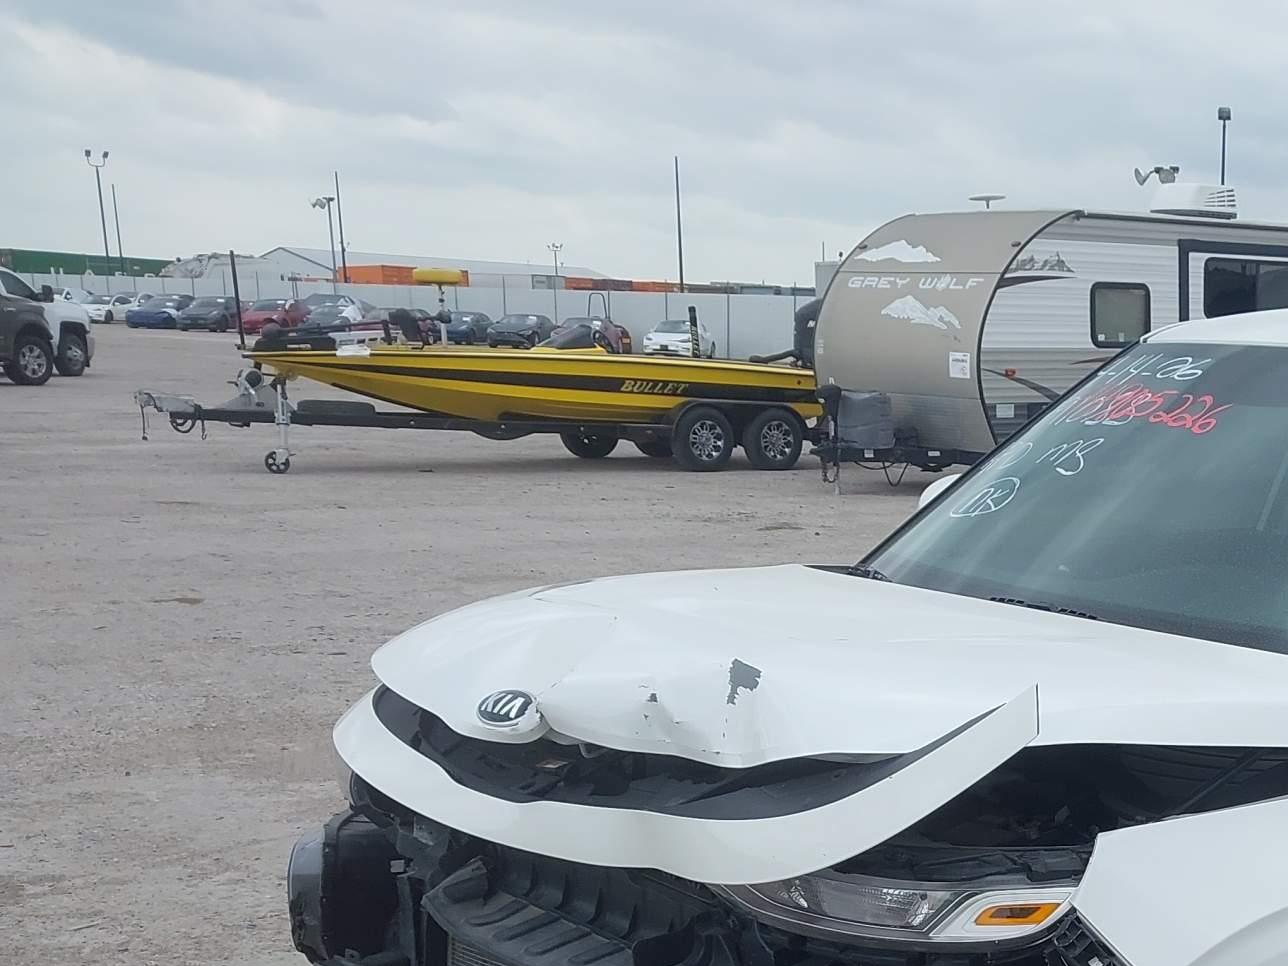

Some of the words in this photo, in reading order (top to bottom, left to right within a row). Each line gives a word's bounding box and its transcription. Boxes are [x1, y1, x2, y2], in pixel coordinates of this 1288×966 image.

[847, 275, 913, 289] GREY
[918, 273, 985, 291] WOLF
[620, 379, 690, 394] BULLET
[480, 692, 526, 719] KIA
